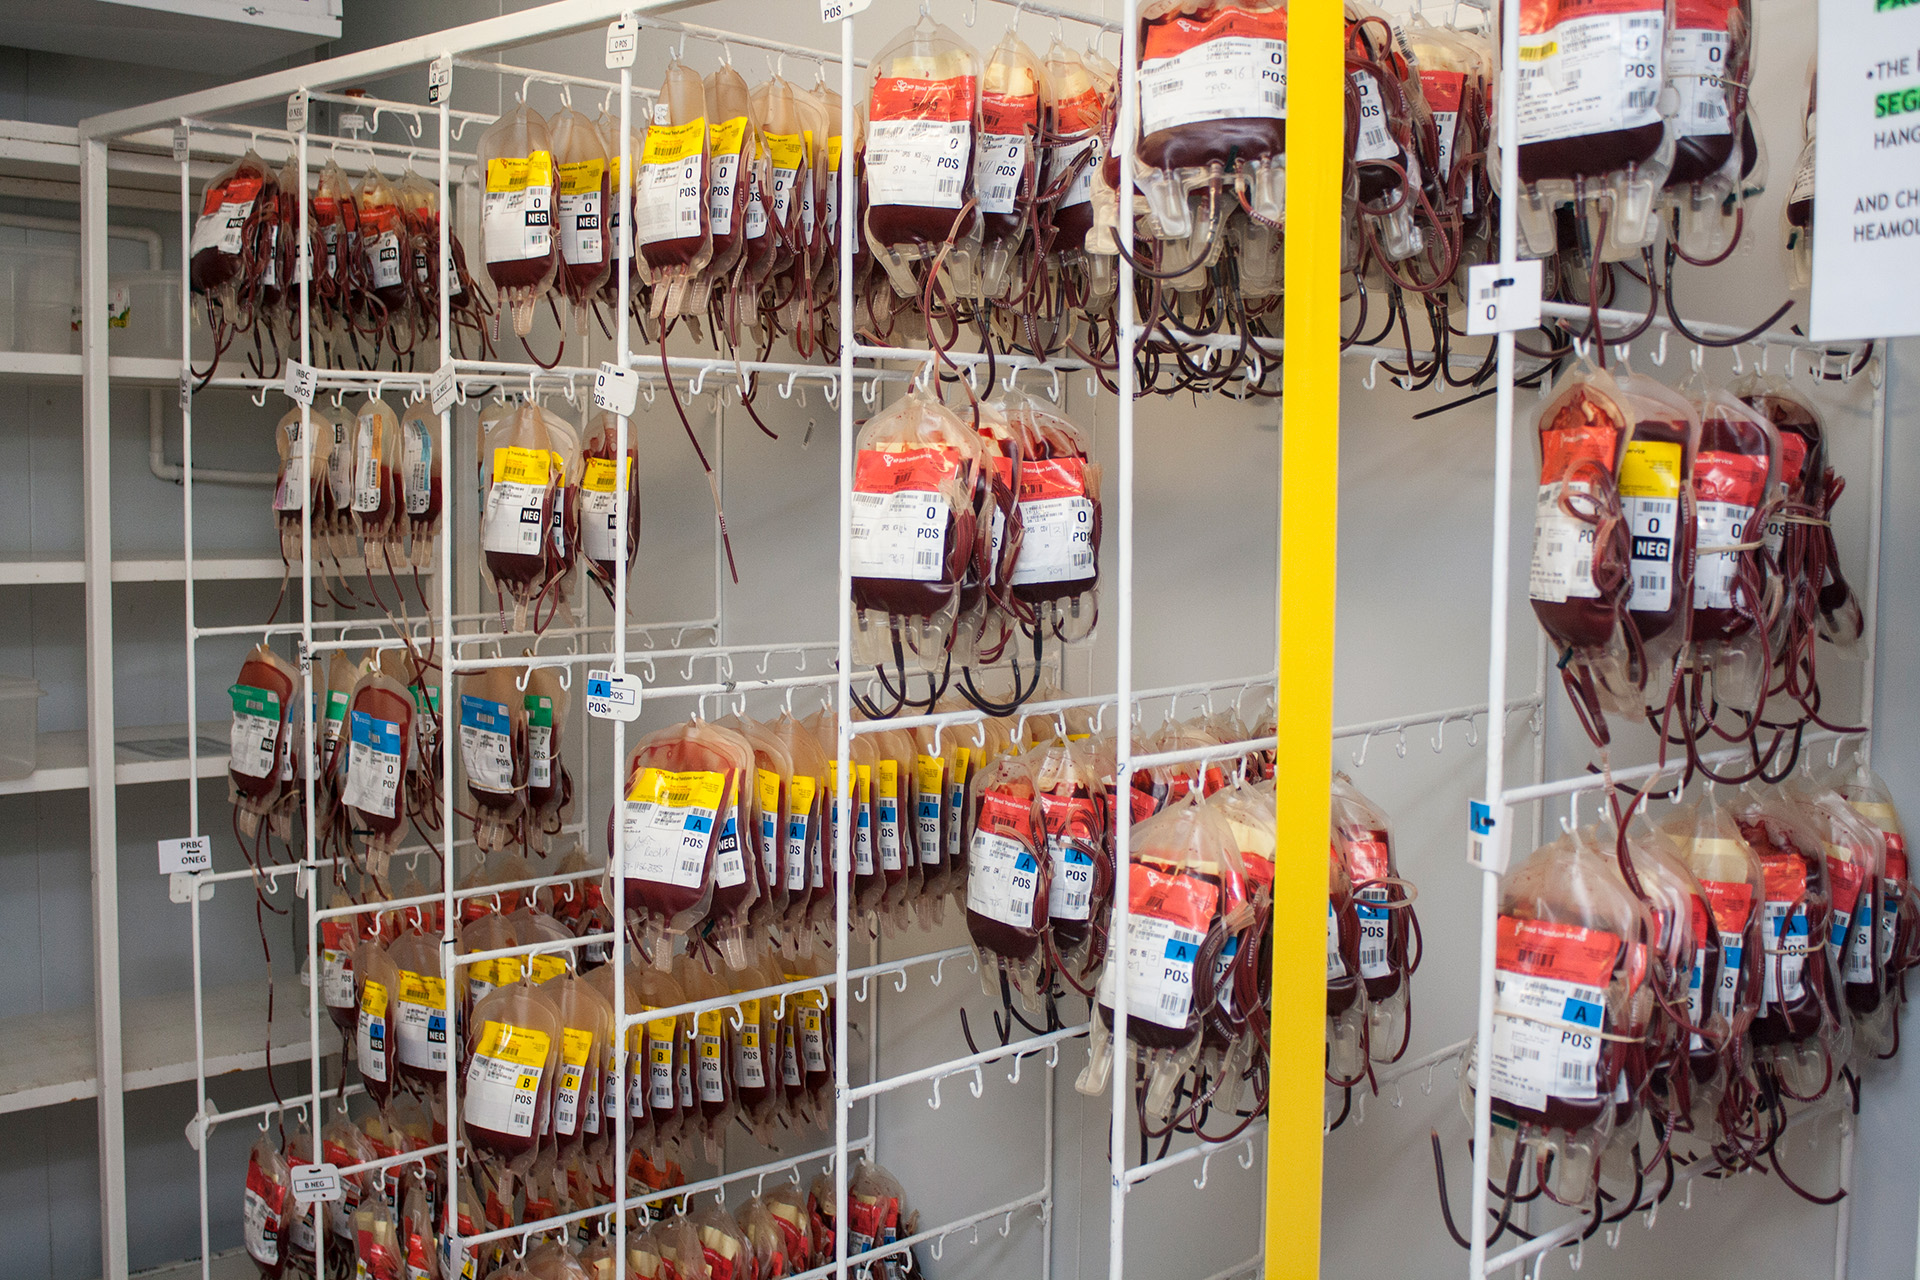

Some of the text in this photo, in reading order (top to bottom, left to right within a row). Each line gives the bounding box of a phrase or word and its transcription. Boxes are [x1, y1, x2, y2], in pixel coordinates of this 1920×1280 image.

[824, 5, 842, 21] POS
[1636, 35, 1648, 51] O
[1271, 52, 1282, 65] O
[1709, 47, 1721, 63] O
[1624, 63, 1655, 79] POS
[1875, 57, 1910, 80] THE
[1262, 69, 1287, 87] POS
[1875, 89, 1920, 118] SEG
[1362, 104, 1380, 118] OS
[950, 138, 958, 149] O
[1089, 138, 1098, 150] O
[1008, 146, 1017, 158] O
[937, 156, 959, 170] POS
[685, 167, 692, 179] O
[719, 166, 727, 178] O
[995, 165, 1017, 177] POS
[680, 186, 697, 197] POS
[712, 186, 729, 197] POS
[775, 180, 783, 191] O
[533, 198, 541, 208] O
[584, 202, 592, 213] O
[1854, 193, 1888, 214] AND
[528, 213, 547, 223] NEG
[579, 216, 598, 227] NEG
[381, 249, 396, 261] NEG
[416, 258, 425, 267] EG
[1486, 304, 1496, 321] O
[598, 374, 606, 387] O
[1712, 457, 1734, 465] Service
[530, 496, 537, 506] O
[522, 511, 539, 521] NEG
[926, 506, 936, 520] O
[1078, 510, 1087, 523] O
[1648, 517, 1660, 534] O
[1731, 523, 1742, 539] O
[916, 527, 940, 539] POS
[1579, 529, 1594, 544] PO
[1636, 541, 1668, 558] NEG
[1720, 551, 1736, 563] PO
[594, 683, 603, 695] A
[588, 701, 607, 713] POS
[498, 743, 505, 753] O
[496, 758, 511, 767] POS
[387, 764, 394, 775] O
[382, 779, 396, 790] POS
[1005, 800, 1023, 808] Transfusion
[880, 810, 888, 821] A
[923, 806, 930, 816] A
[693, 819, 702, 831] A
[881, 827, 894, 838] OS
[180, 840, 203, 850] PRBC
[682, 836, 704, 849] POS
[718, 837, 735, 851] NEG
[789, 844, 800, 855] OS
[1074, 850, 1083, 863] A
[1021, 858, 1031, 870] A
[1065, 869, 1087, 882] POS
[1012, 876, 1031, 890] POS
[1361, 926, 1384, 938] POS
[1175, 945, 1187, 960] A
[1215, 961, 1230, 974] OS
[1164, 967, 1189, 984] POS
[1574, 1005, 1587, 1022] A
[434, 1018, 440, 1028] A
[809, 1019, 815, 1028] B
[373, 1026, 379, 1036] A
[429, 1031, 445, 1041] NEG
[371, 1038, 383, 1050] NEG
[746, 1035, 752, 1045] B
[805, 1034, 819, 1043] POS
[1561, 1030, 1593, 1050] POS
[657, 1052, 664, 1062] B
[706, 1046, 713, 1056] B
[743, 1051, 758, 1060] POS
[702, 1061, 717, 1071] POS
[652, 1067, 668, 1078] POS
[523, 1078, 530, 1088] B
[566, 1077, 573, 1087] B
[606, 1075, 615, 1086] PO
[515, 1094, 532, 1106] POS
[558, 1092, 574, 1104] POS
[649, 1209, 659, 1218] EG
